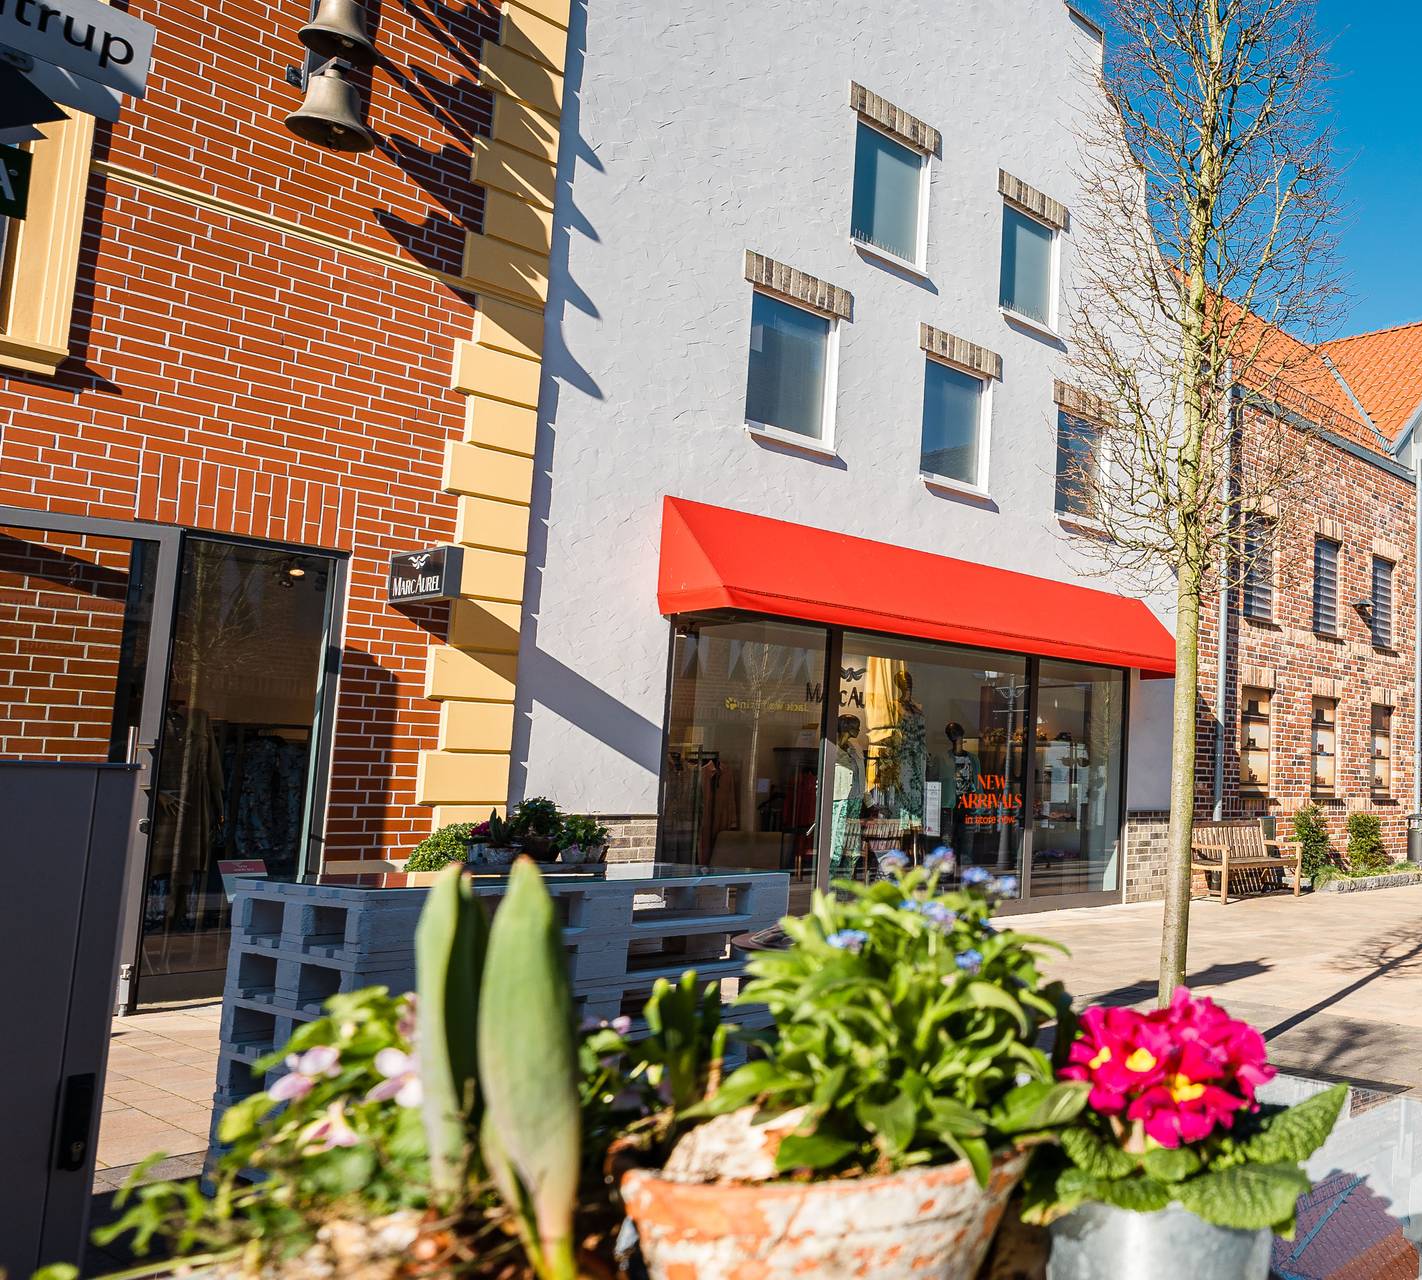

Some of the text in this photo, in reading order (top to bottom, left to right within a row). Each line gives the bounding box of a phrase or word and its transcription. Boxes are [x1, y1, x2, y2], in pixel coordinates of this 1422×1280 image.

[0, 0, 134, 68] trup
[977, 774, 1006, 790] NEW
[958, 793, 1022, 809] ARRIVALS
